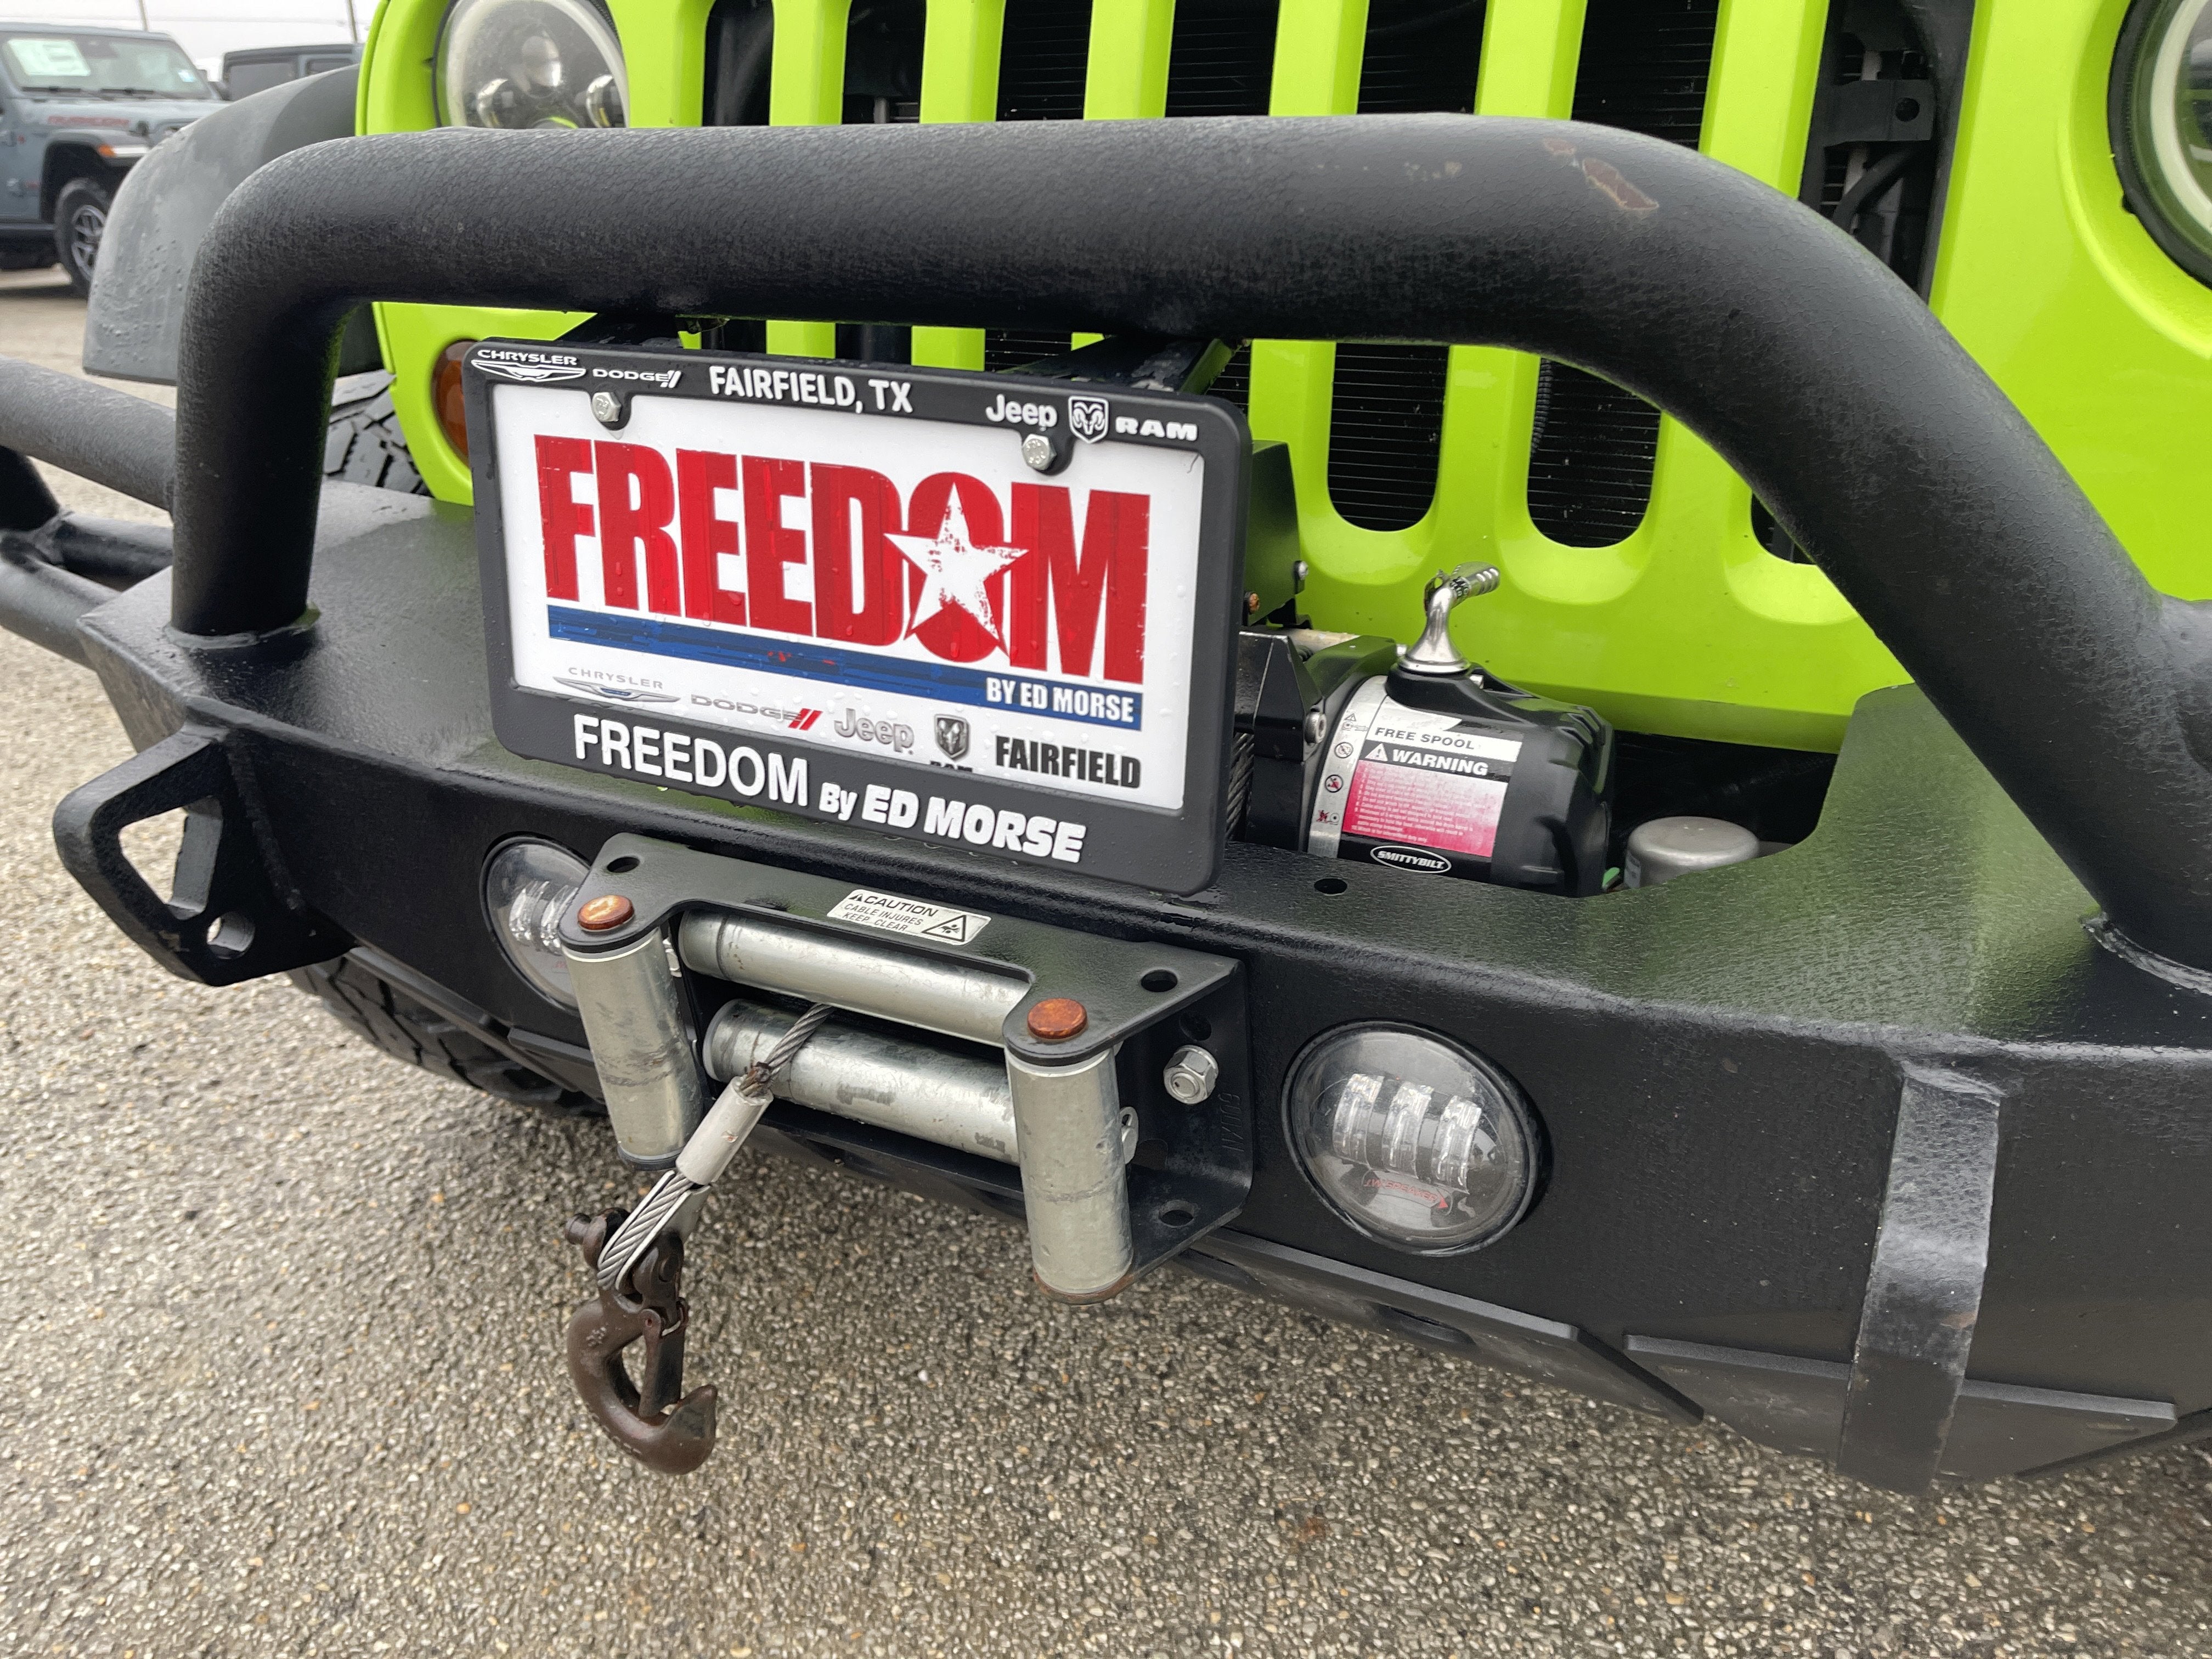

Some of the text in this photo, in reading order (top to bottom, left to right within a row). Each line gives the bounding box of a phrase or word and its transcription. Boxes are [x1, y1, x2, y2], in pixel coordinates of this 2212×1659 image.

[477, 349, 577, 366] CHRYSLER
[592, 369, 670, 382] DODGE
[709, 366, 913, 413] FAIRFIELD, TX
[985, 394, 1058, 428] Jeep
[1115, 416, 1198, 441] RAM
[534, 433, 1150, 685] FREEDOM
[568, 667, 663, 690] CHRYSLER
[691, 694, 803, 721] DODGE
[986, 677, 1134, 723] BY ED MORSE
[834, 708, 915, 754] Jeep
[1374, 727, 1475, 750] FREE SPOOL
[996, 735, 1141, 788] FAIRFIELD
[1392, 749, 1488, 776] WARNING
[573, 714, 1087, 864] FREEDOM By ED MORSE
[1377, 850, 1445, 869] SMITTYBILT
[843, 904, 878, 916] CABLE
[864, 895, 938, 917] CAUTION
[843, 912, 908, 932] KEEP CLEAR
